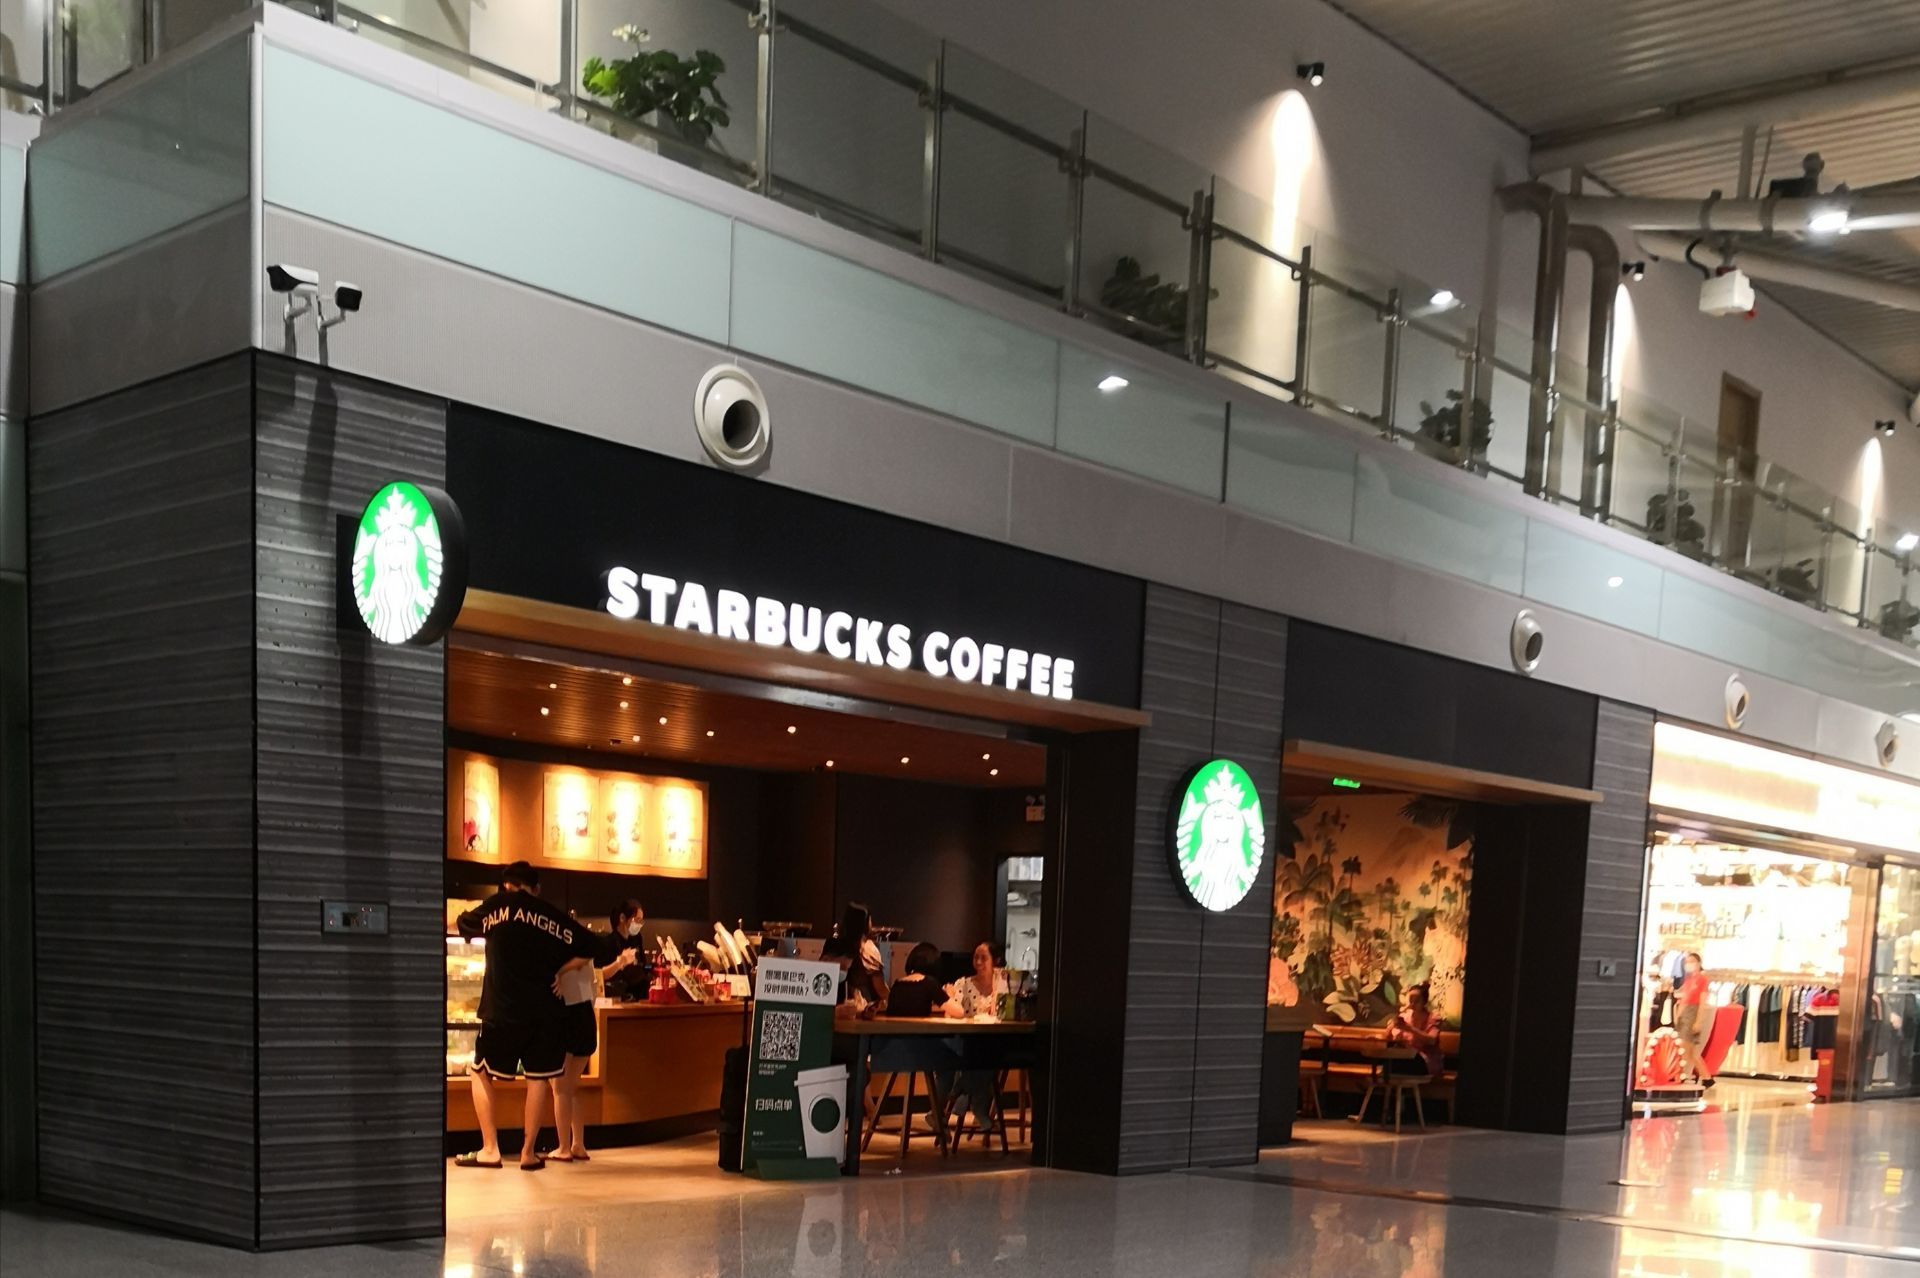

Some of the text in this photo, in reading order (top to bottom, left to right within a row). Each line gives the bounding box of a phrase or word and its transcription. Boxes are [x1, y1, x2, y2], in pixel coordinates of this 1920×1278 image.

[605, 566, 1075, 700] STARBUCKS COFFEE
[482, 907, 573, 945] PALM ANGELS
[755, 1098, 793, 1111] 扫码点单
